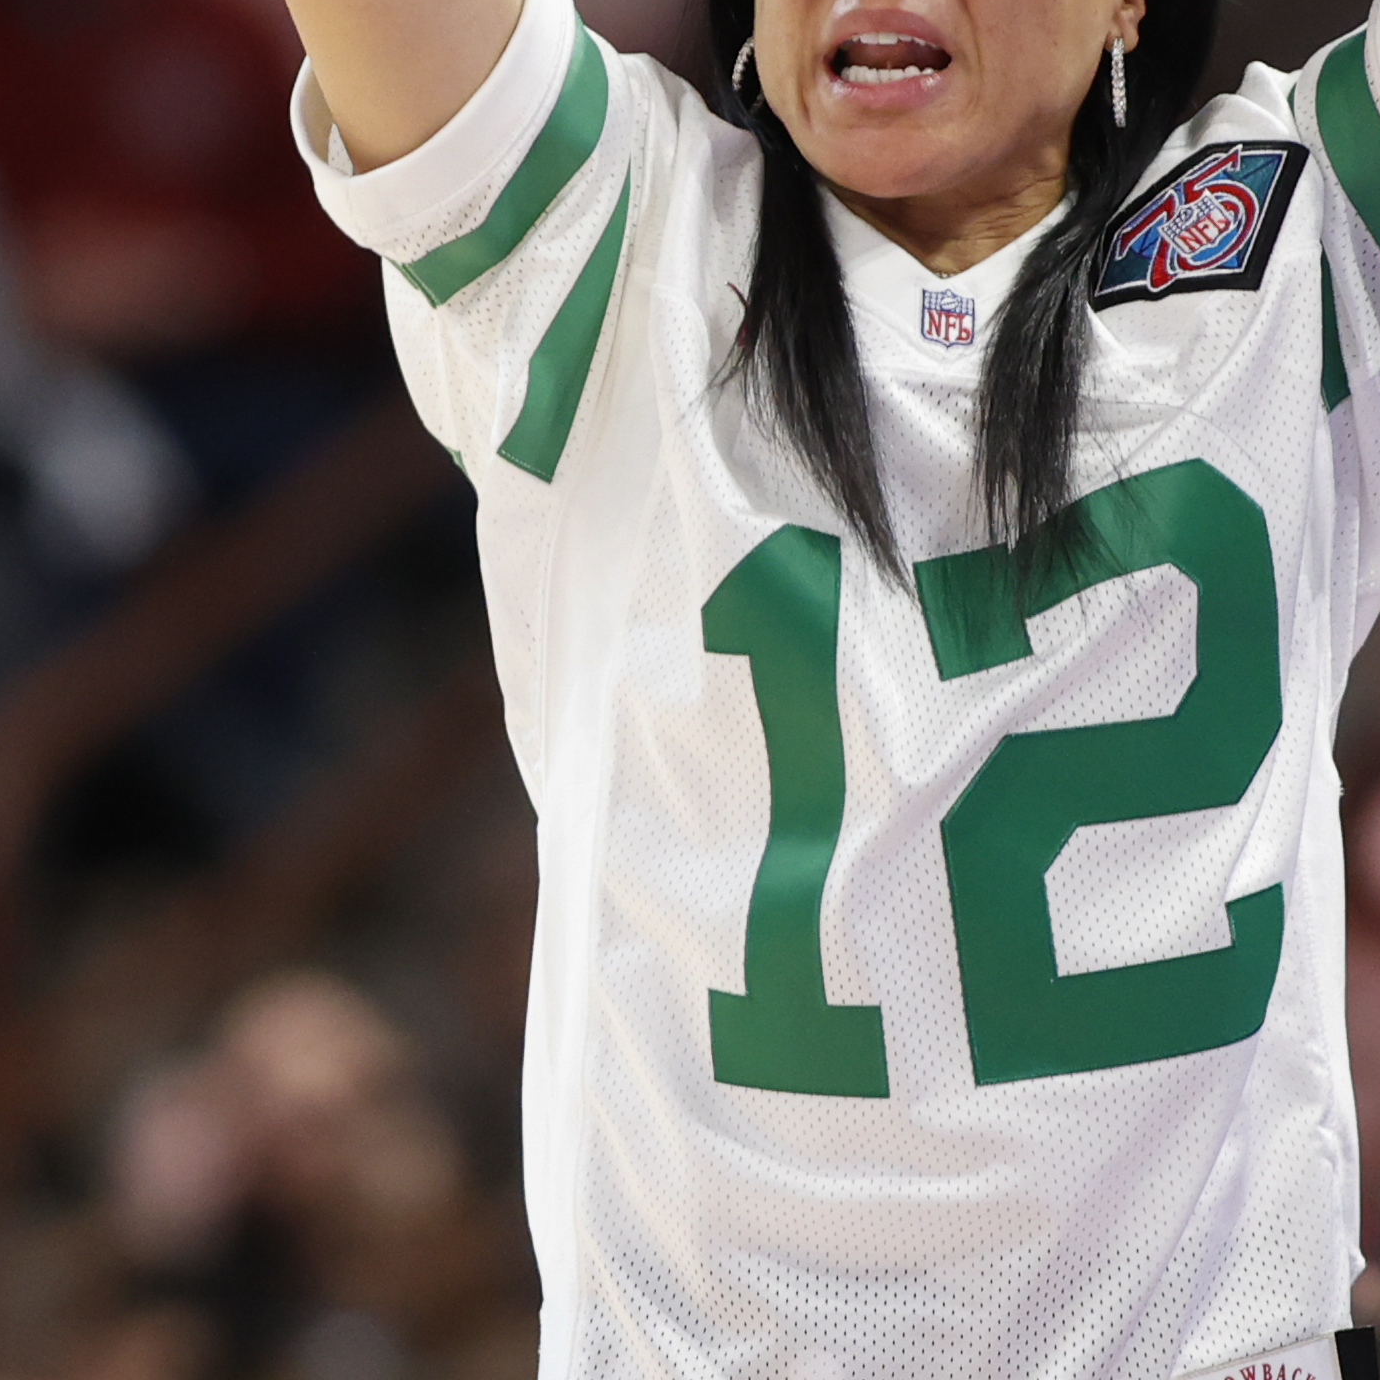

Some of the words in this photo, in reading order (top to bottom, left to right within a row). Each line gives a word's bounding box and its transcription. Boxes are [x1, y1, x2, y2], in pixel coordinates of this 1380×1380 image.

[1115, 144, 1259, 292] 75
[1177, 213, 1231, 251] NFL
[926, 309, 971, 341] NFL
[701, 458, 1284, 1098] 12
